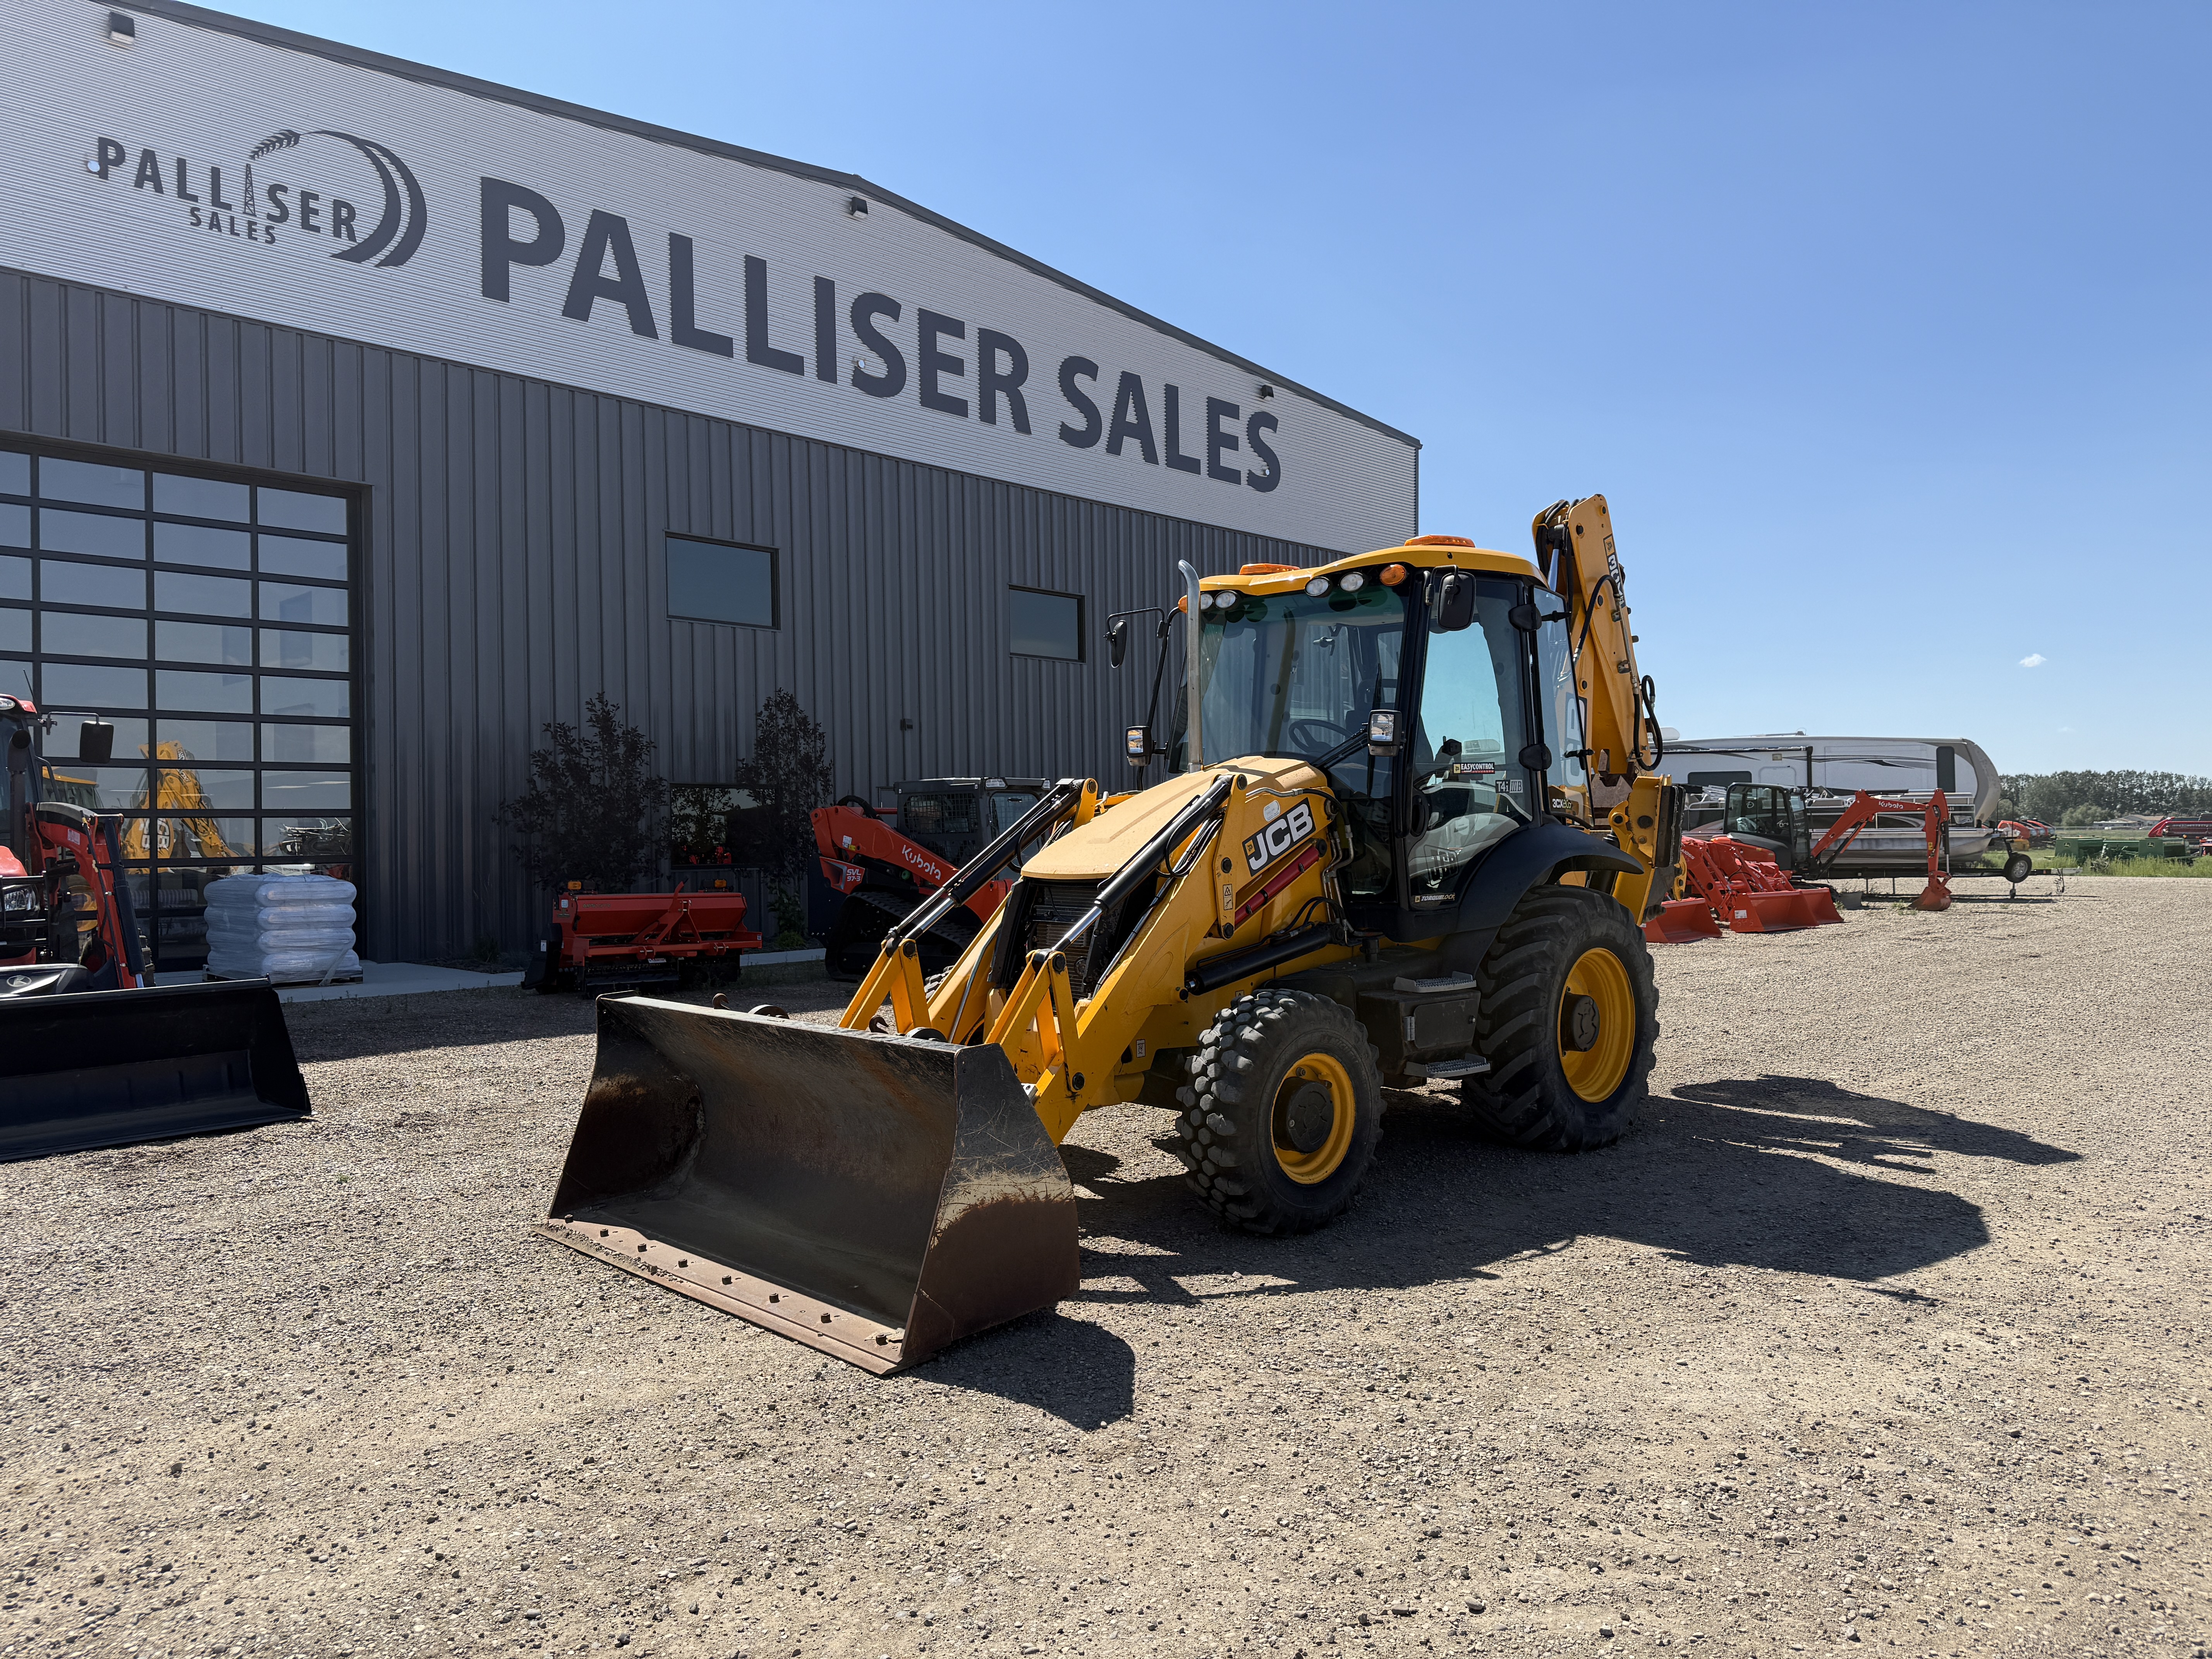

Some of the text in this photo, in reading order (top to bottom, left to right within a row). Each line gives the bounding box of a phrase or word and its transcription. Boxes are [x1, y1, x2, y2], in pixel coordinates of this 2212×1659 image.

[98, 136, 357, 243] PALLISER
[190, 207, 276, 245] SALES
[481, 176, 1282, 493] PALLISER SALES
[1461, 763, 1494, 772] EASYCONTROL
[1496, 781, 1509, 792] T4i
[1879, 801, 1904, 809] Kubota
[1249, 803, 1313, 870] JCB
[901, 844, 941, 880] Kubota
